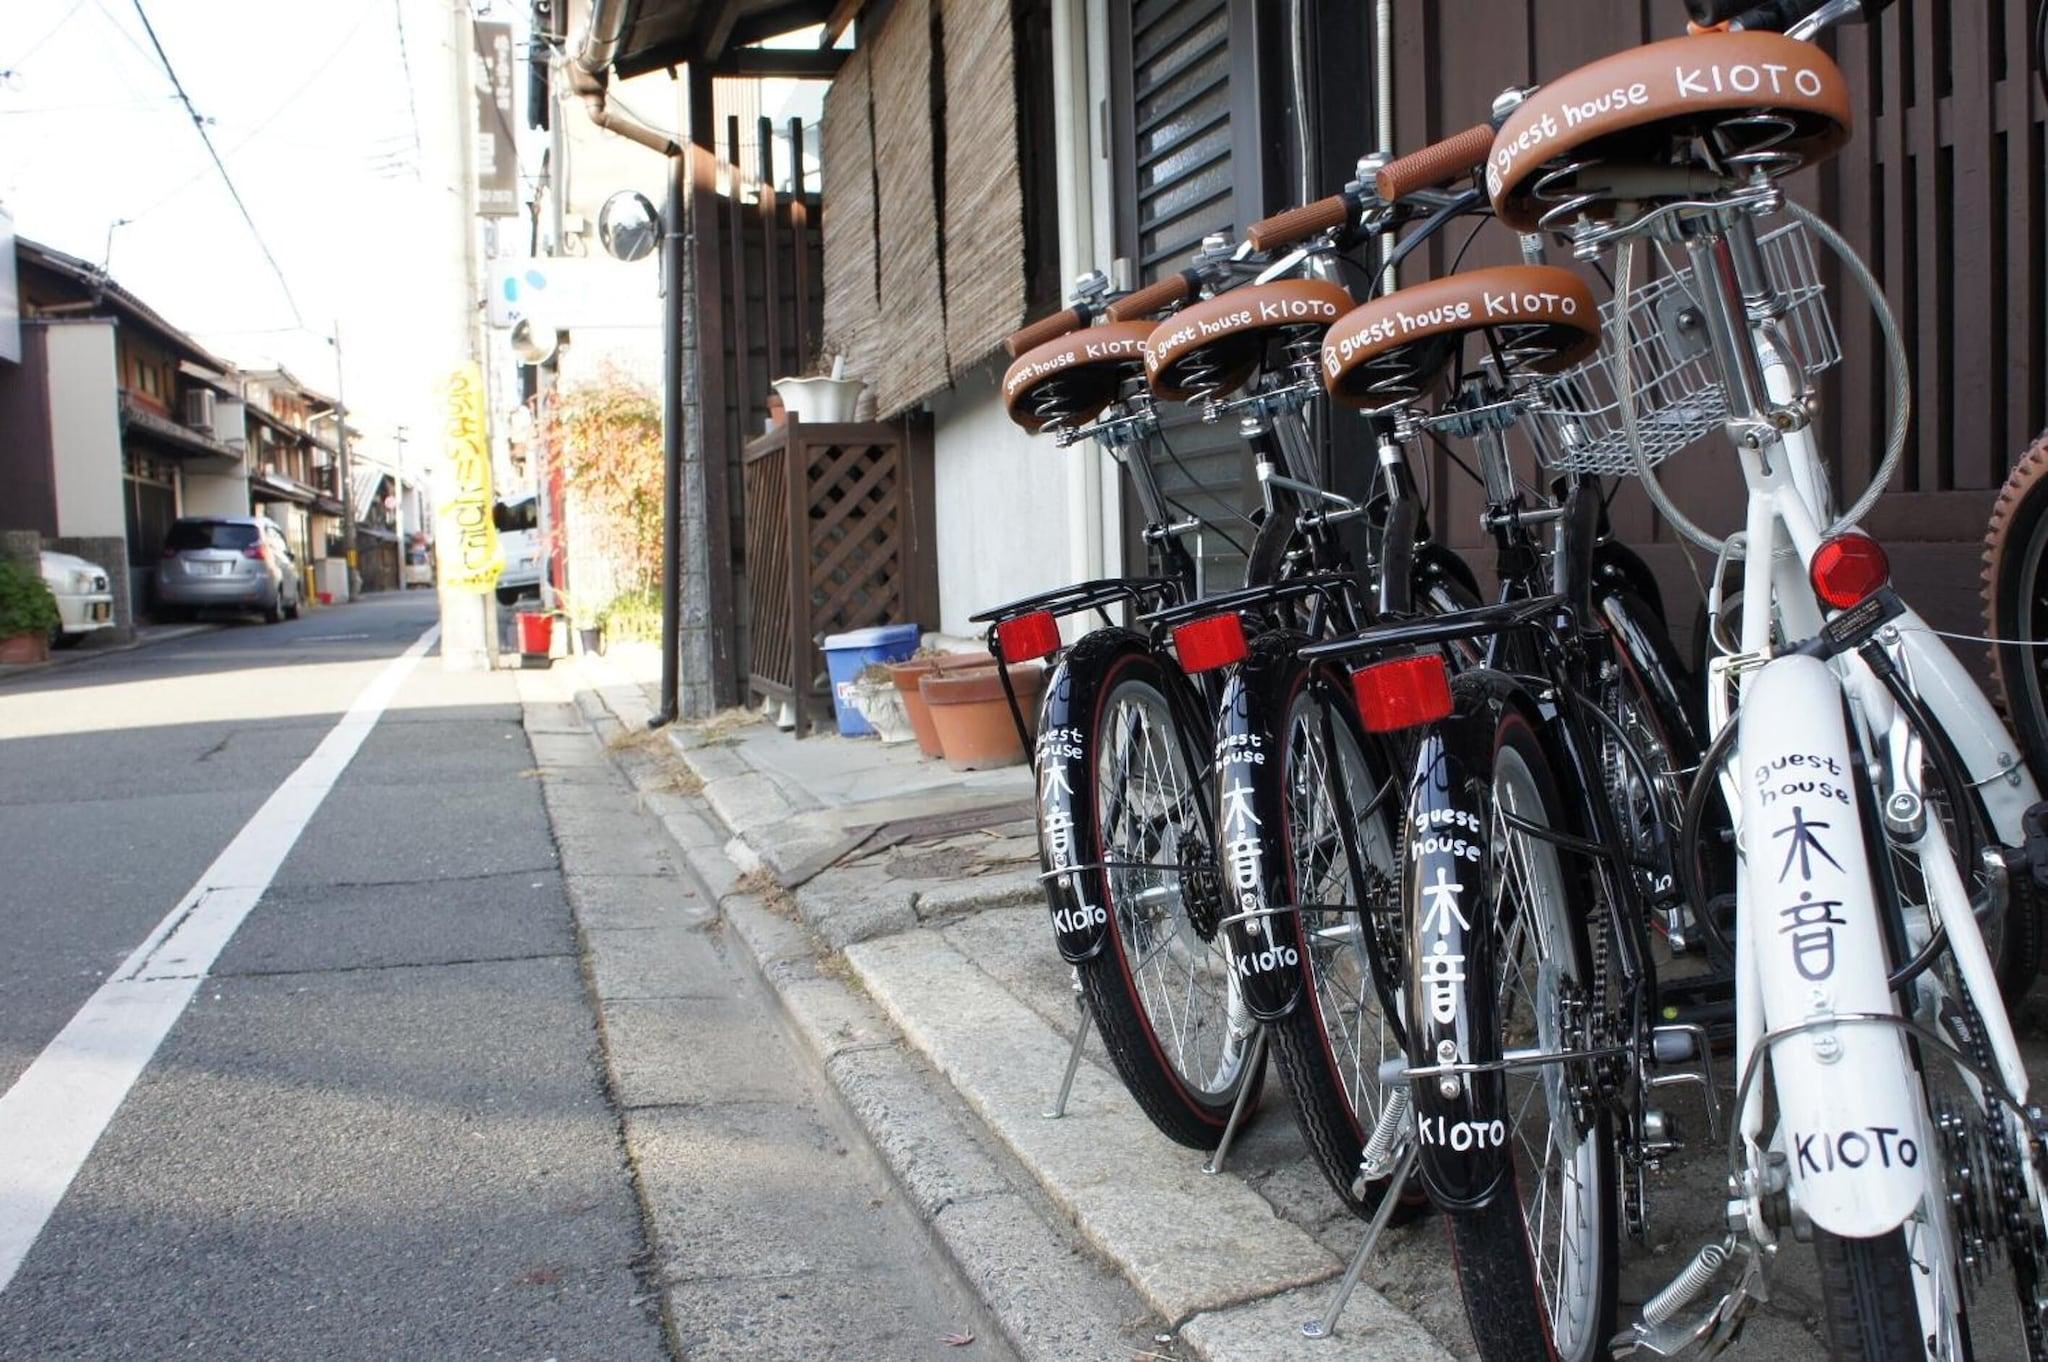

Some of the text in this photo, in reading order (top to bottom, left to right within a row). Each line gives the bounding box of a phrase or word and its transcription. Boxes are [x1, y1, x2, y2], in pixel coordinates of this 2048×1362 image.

[1498, 64, 1821, 175] guest house KIOTO
[1158, 300, 1336, 359] guest house KIOTO
[1340, 291, 1576, 361] guest house KIOTO
[1006, 339, 1147, 395] guest house KIOTO
[1754, 751, 1842, 786] guest
[1759, 780, 1850, 807] house
[1042, 757, 1075, 852] 木音
[1223, 778, 1263, 889] 木音
[1415, 808, 1480, 833] guest
[1411, 836, 1481, 862] house
[1771, 806, 1847, 982] 木音
[1421, 867, 1471, 1024] 木音
[1418, 1112, 1505, 1151] KIOTO
